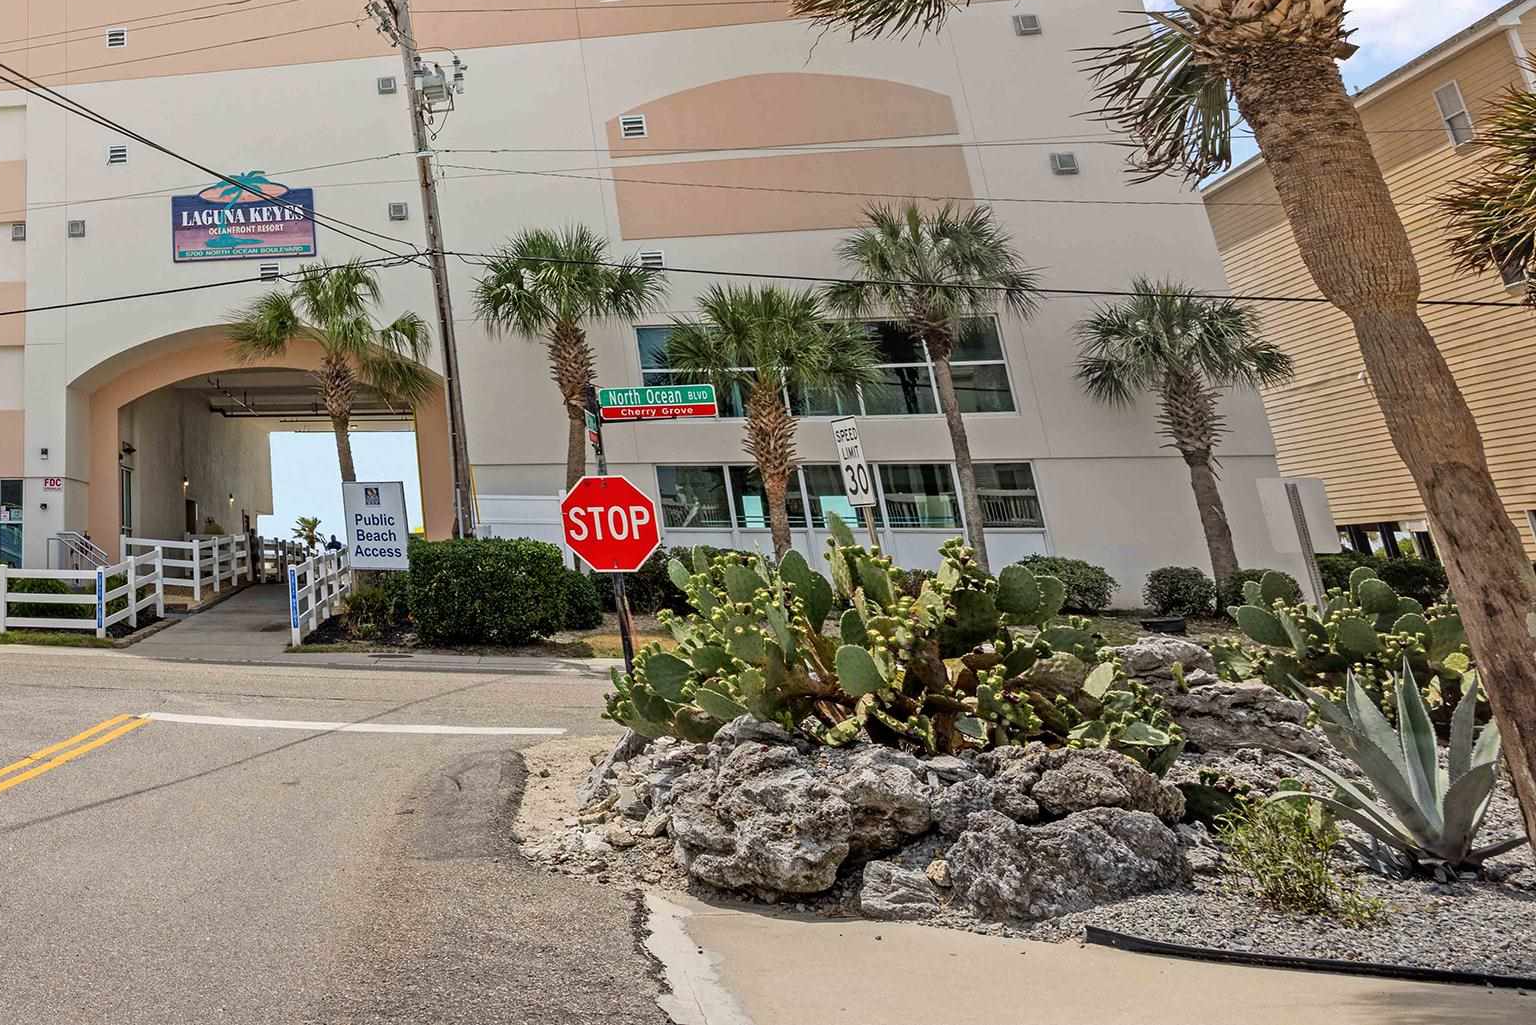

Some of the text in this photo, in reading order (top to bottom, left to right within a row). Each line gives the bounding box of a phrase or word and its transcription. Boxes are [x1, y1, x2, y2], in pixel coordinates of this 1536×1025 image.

[182, 205, 304, 226] LAGUNA KEYES
[208, 224, 284, 235] OCEANFRONT RESORT
[260, 246, 303, 254] BOULEVARD
[608, 389, 708, 405] North Ocean BLVD
[620, 407, 694, 416] Cherry Grove
[835, 427, 858, 442] SPEED
[842, 445, 860, 460] LIMIT
[44, 478, 62, 487] FDC
[845, 463, 869, 496] 30
[355, 513, 395, 526] Public
[568, 505, 650, 541] STOP
[356, 529, 397, 541] Beach
[355, 544, 402, 557] Access
